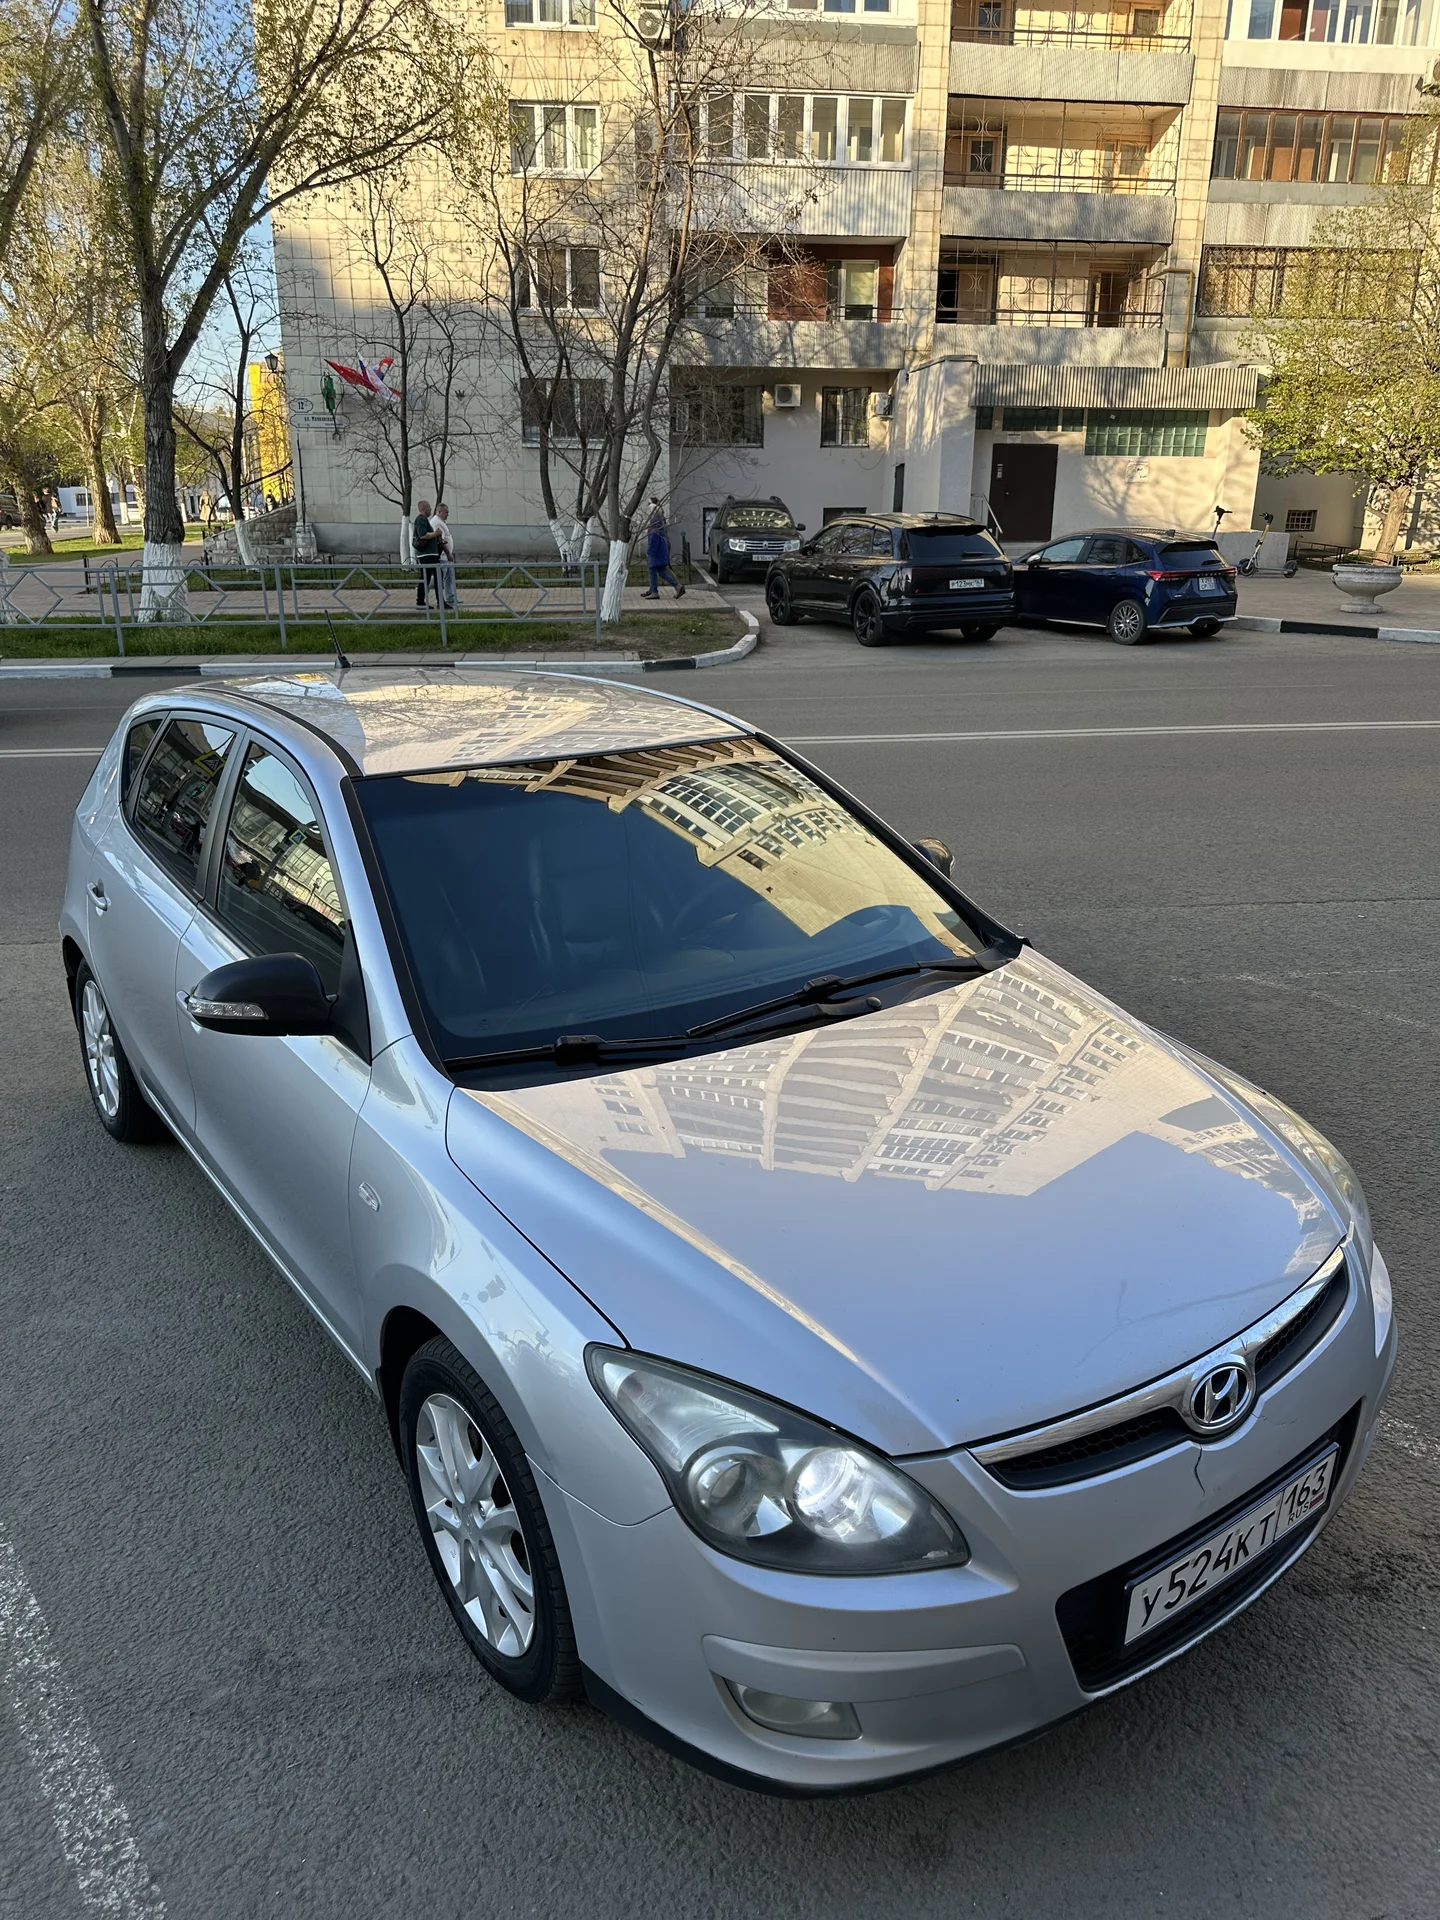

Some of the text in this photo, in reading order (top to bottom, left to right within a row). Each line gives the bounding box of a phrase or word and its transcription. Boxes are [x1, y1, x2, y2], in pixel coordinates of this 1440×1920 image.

[298, 401, 304, 410] 12
[1285, 1461, 1328, 1515] 163
[1287, 1502, 1310, 1525] RUS
